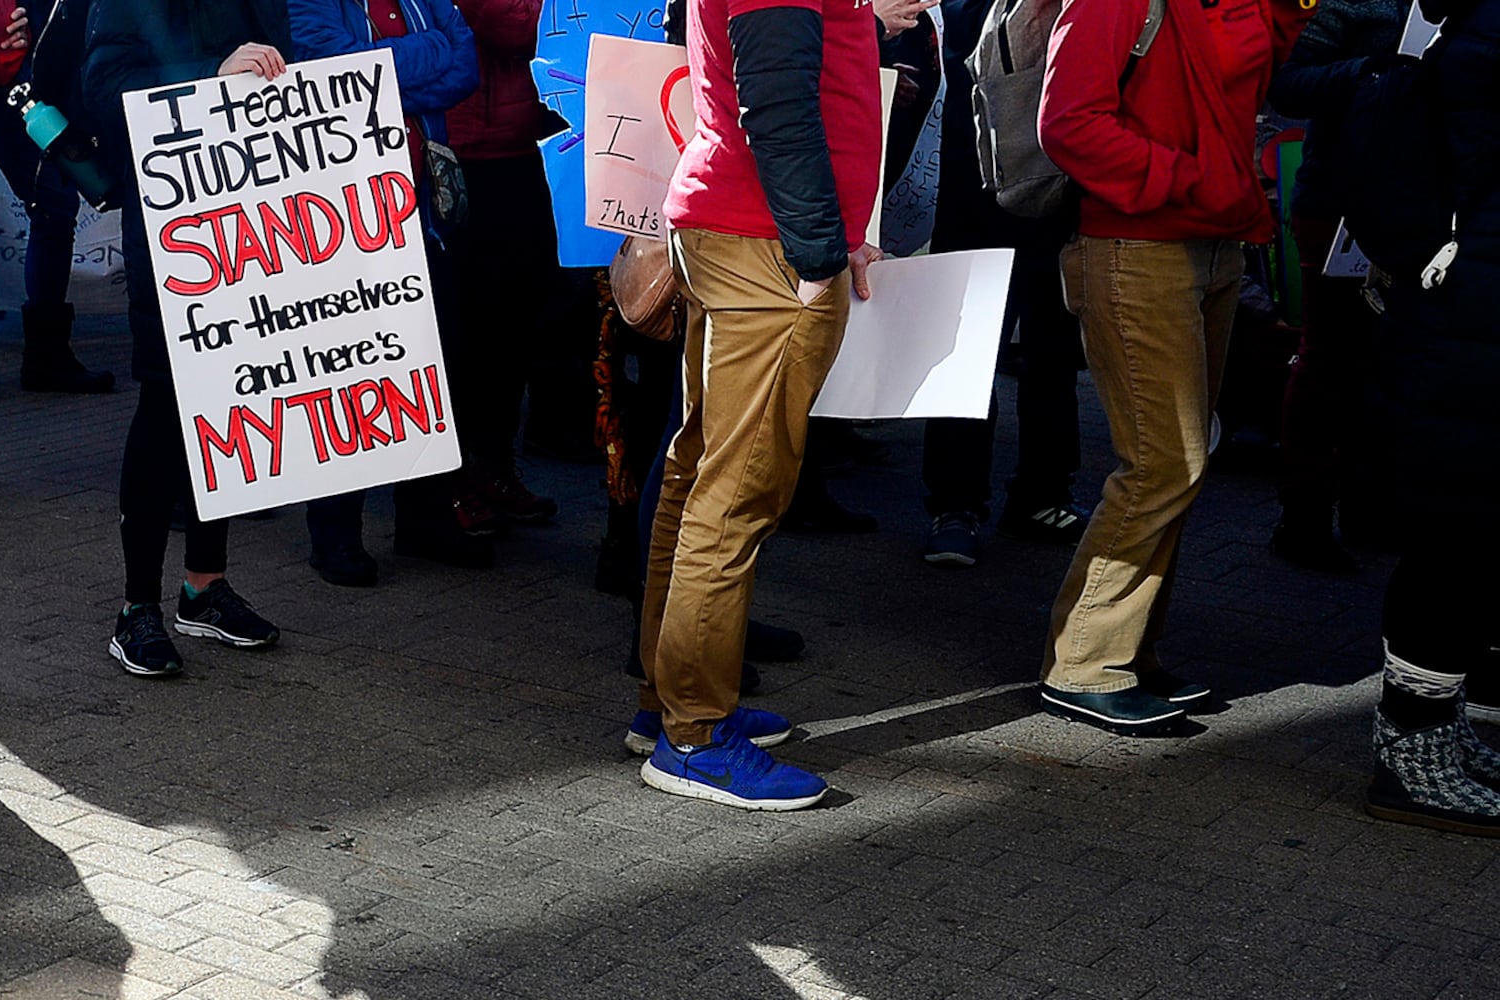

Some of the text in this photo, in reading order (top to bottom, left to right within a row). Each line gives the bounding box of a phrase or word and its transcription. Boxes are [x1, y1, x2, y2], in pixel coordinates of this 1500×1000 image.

[615, 8, 662, 38] yo
[148, 63, 383, 146] I teach my
[595, 115, 641, 161] I
[141, 112, 405, 211] STUDENTS to
[159, 171, 418, 296] STAND UP
[600, 199, 660, 231] That's
[178, 275, 425, 353] for themselves
[234, 331, 407, 396] and here's
[193, 364, 447, 493] MY TURN!
